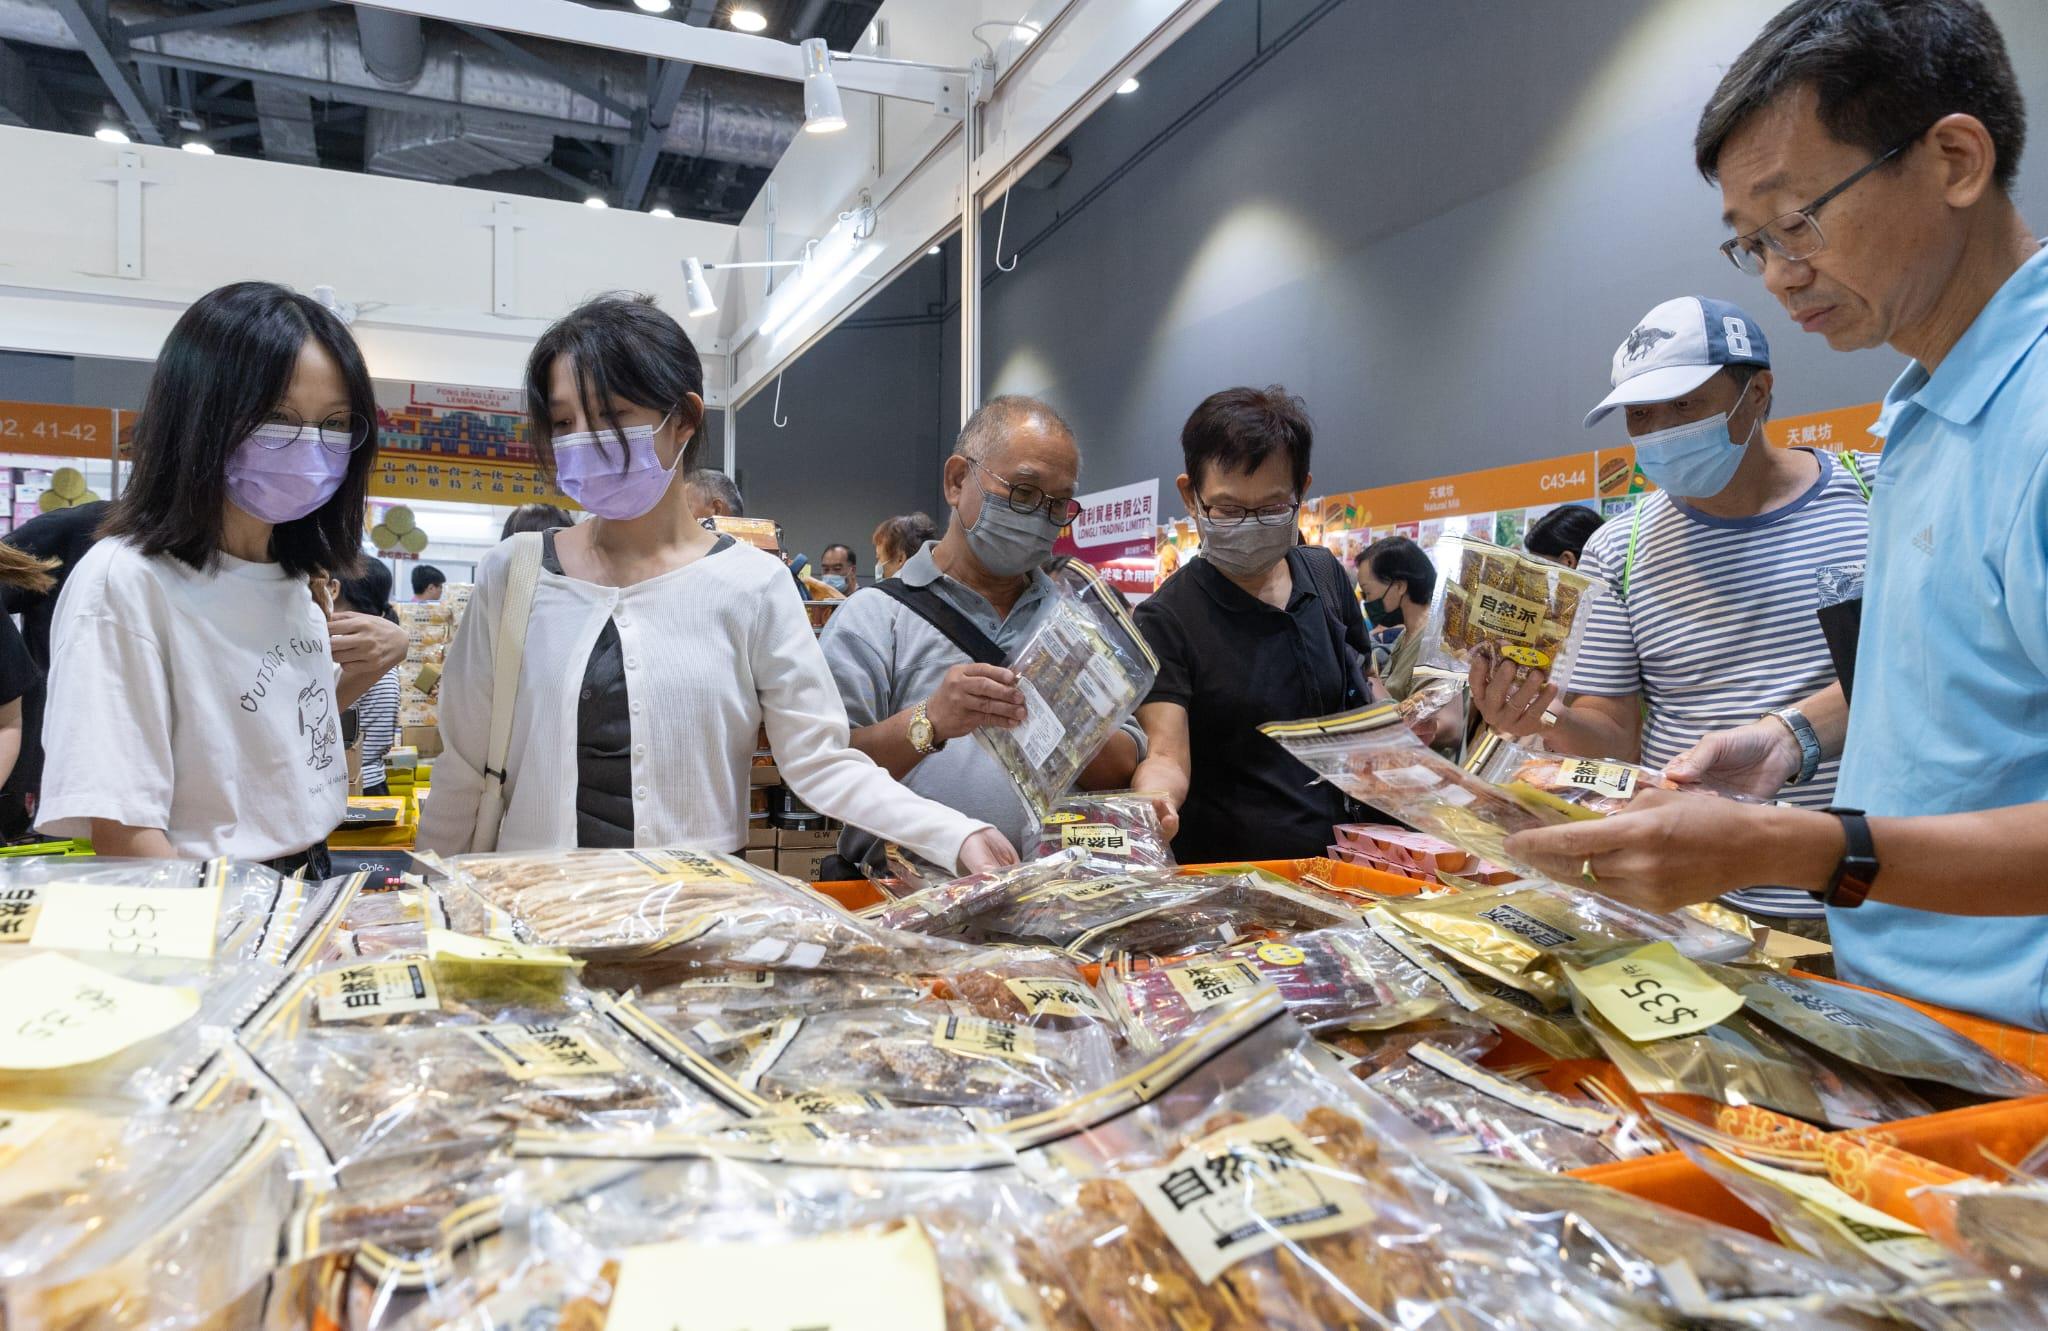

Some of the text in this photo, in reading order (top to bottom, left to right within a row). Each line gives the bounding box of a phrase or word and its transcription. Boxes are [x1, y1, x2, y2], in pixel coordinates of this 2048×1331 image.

[1723, 316, 1752, 357] 8
[436, 387, 459, 397] FONG
[461, 389, 481, 399] SENG
[0, 418, 97, 441] 2, 41-42
[1786, 422, 1833, 446] 天賦坊
[1540, 469, 1585, 491] C43-44
[1078, 525, 1098, 540] LONGLI
[1099, 520, 1124, 537] TRADING
[1479, 594, 1538, 625] 自然派
[240, 637, 325, 713] OUTSIDE FUN
[1188, 966, 1234, 1002] 自然派
[1158, 1135, 1317, 1212] 自然派
